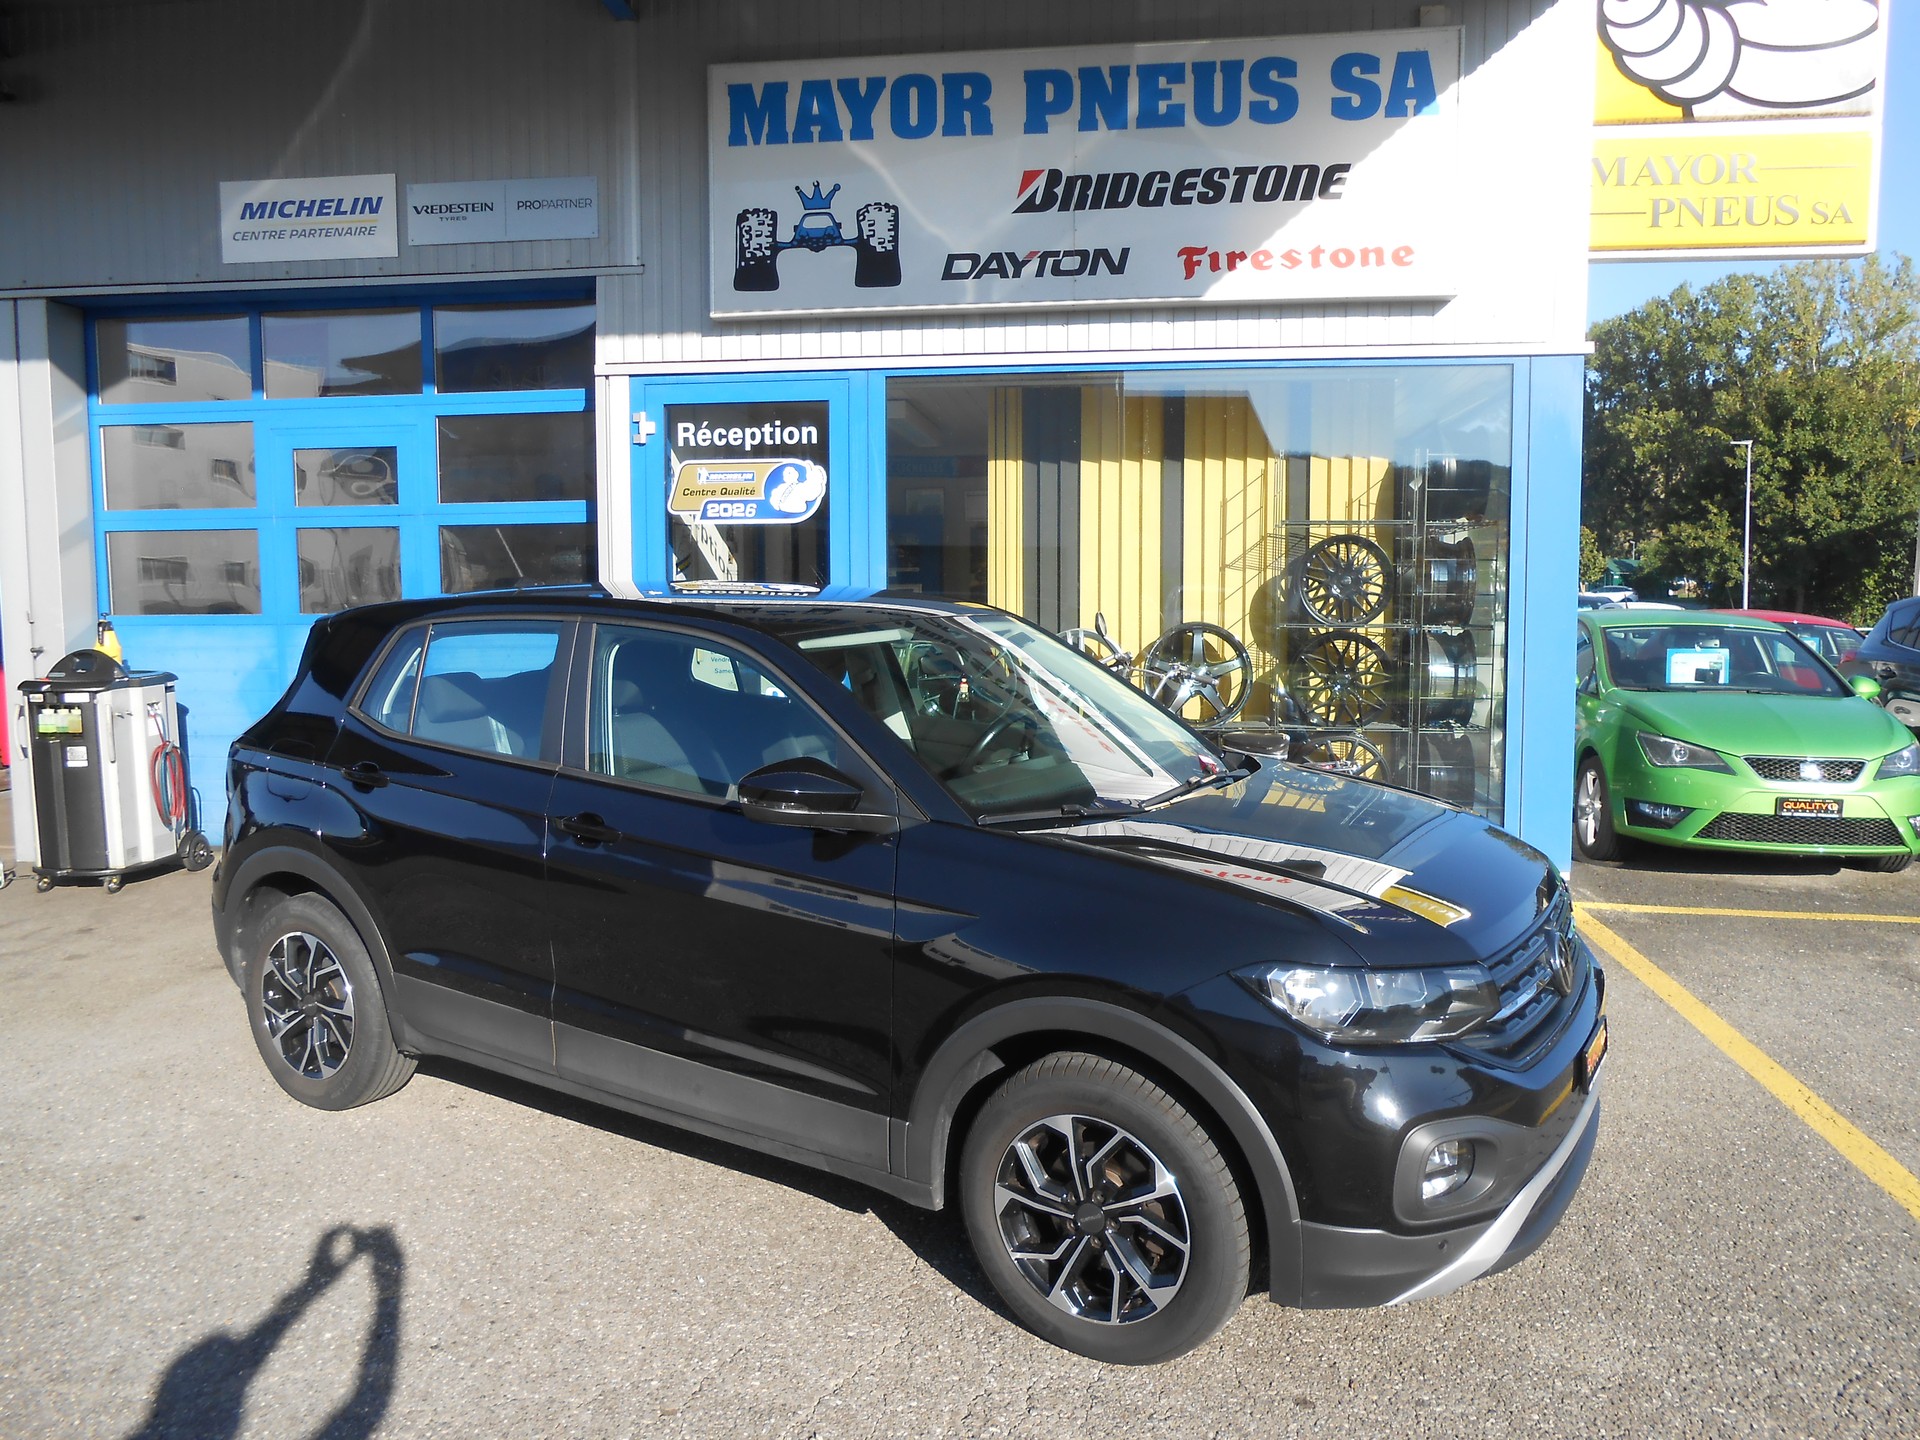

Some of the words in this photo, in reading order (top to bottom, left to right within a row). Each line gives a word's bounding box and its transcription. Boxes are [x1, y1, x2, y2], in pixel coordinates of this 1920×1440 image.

[727, 72, 993, 148] MAYOR
[1023, 56, 1299, 135] PNEUS
[1331, 50, 1440, 119] SA
[1590, 153, 1759, 187] MAYOR
[240, 196, 384, 220] MICHELIN
[412, 202, 494, 215] VREDESTEIN
[517, 198, 593, 211] PROPARTNER
[1648, 194, 1800, 229] PNEUS
[1810, 201, 1854, 225] SA
[232, 229, 287, 242] CENTRE
[289, 225, 378, 240] PARTENAIRE
[941, 247, 1131, 281] DAYTON
[1176, 245, 1416, 281] Firestone
[677, 420, 818, 451] Réception
[682, 488, 717, 497] Centre
[720, 487, 756, 496] Qualité
[706, 503, 758, 518] 2026
